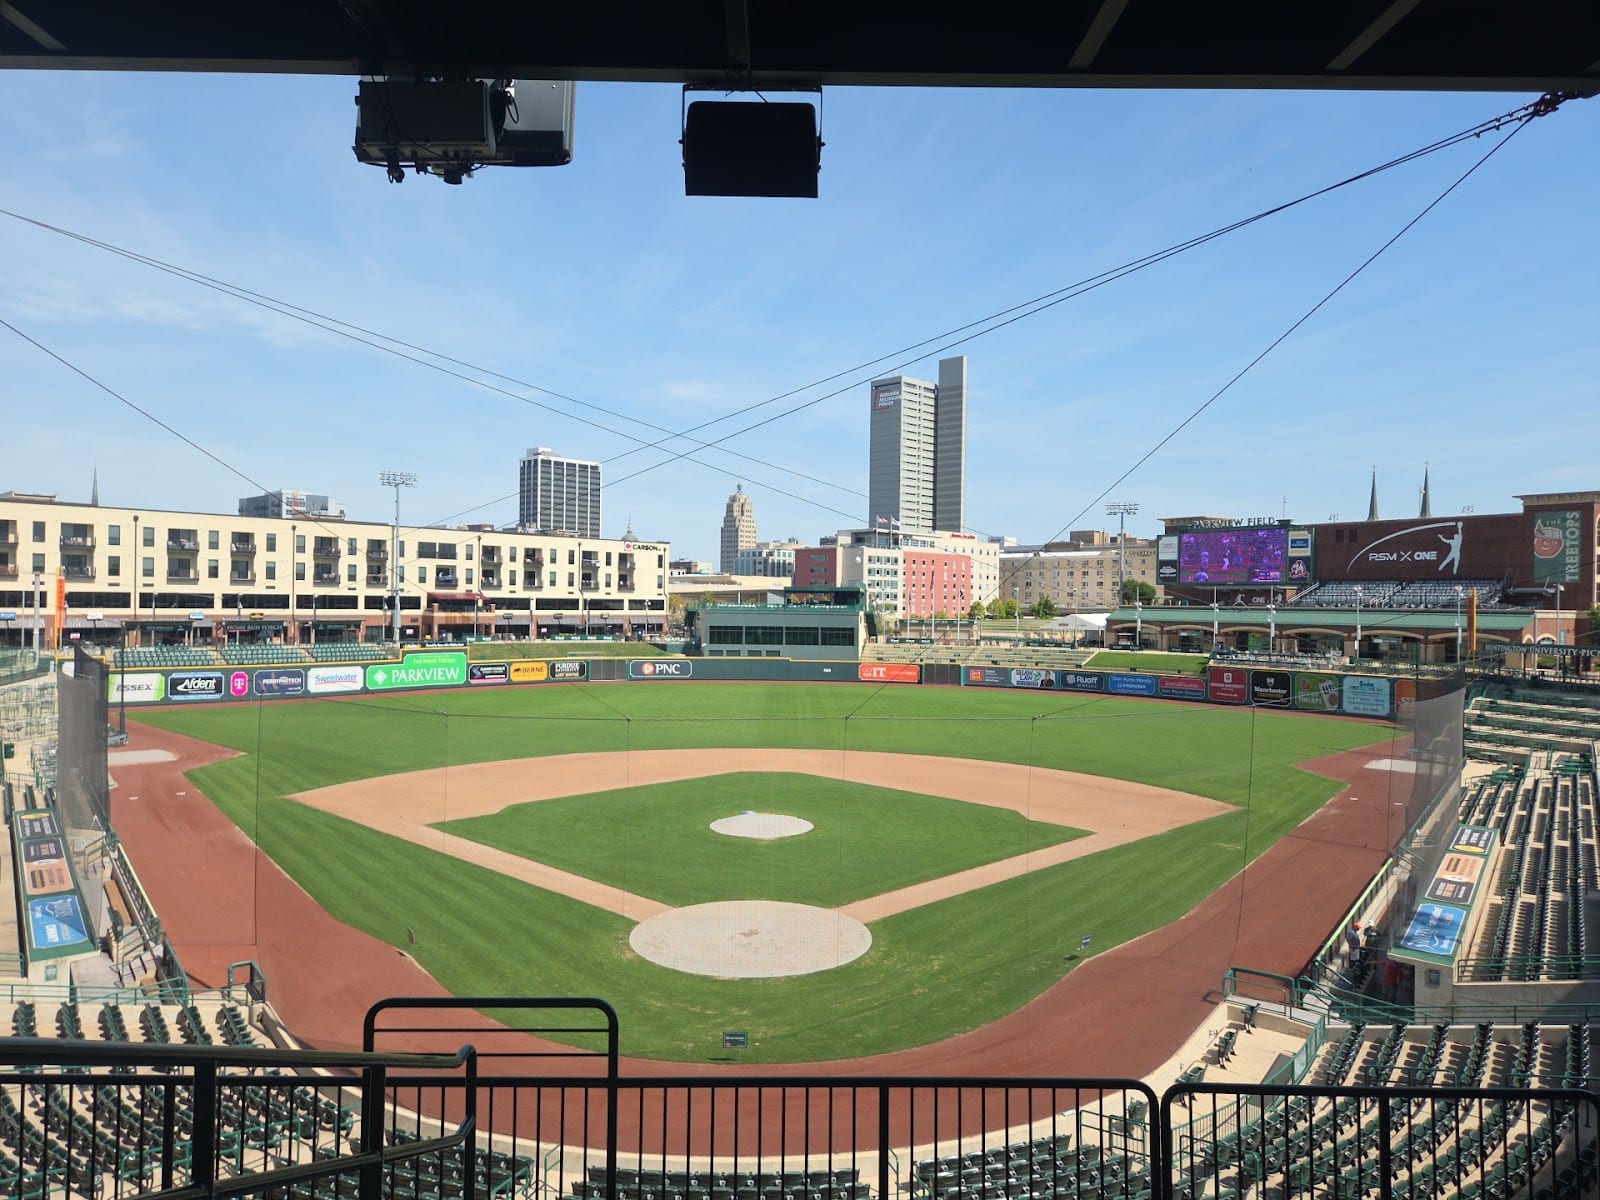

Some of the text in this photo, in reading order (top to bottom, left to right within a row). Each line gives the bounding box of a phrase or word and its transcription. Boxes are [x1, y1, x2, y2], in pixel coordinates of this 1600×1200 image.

[1192, 516, 1276, 529] PARKVIEW FIELD
[1565, 511, 1579, 582] TREETOPS
[1414, 551, 1438, 560] ONE
[1485, 643, 1526, 653] HUNTINGTON
[1529, 647, 1577, 656] UNIVERSITY
[655, 663, 680, 674] PNC
[872, 667, 886, 677] IT
[315, 673, 357, 682] Sweetwater
[391, 667, 459, 682] PARKVIEW
[1076, 675, 1098, 684] Ruoff
[234, 678, 243, 689] T
[1254, 686, 1288, 694] Manchester
